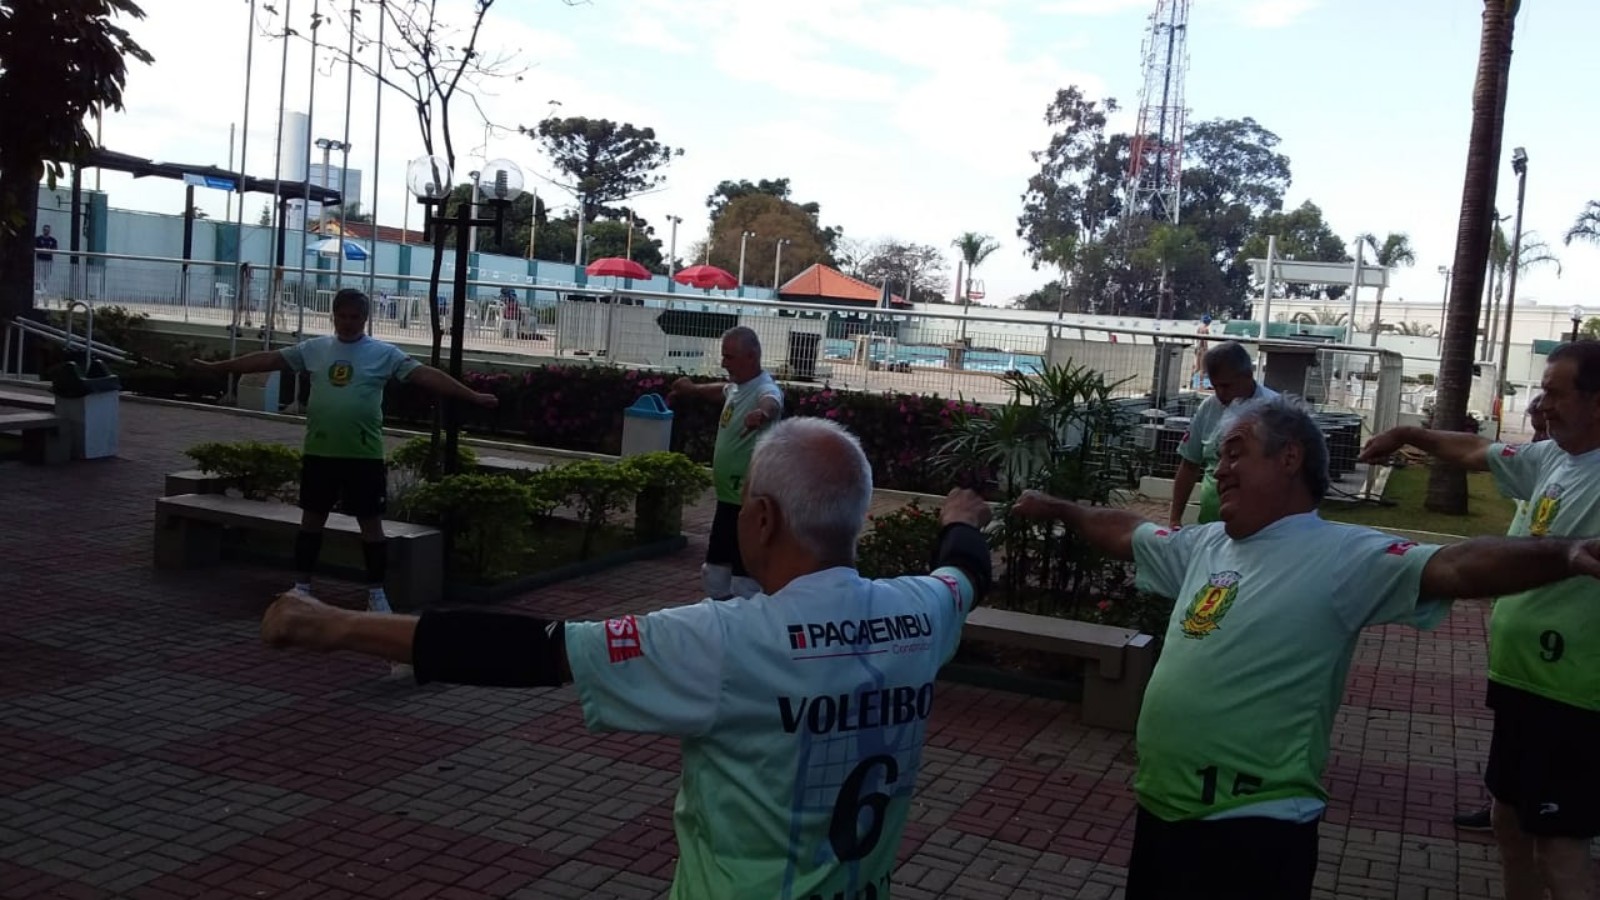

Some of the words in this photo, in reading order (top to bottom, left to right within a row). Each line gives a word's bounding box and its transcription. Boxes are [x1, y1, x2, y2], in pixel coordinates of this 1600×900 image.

[730, 475, 741, 490] 7
[808, 613, 933, 648] PACAEMBU
[1539, 629, 1565, 663] 9
[829, 754, 899, 863] 6
